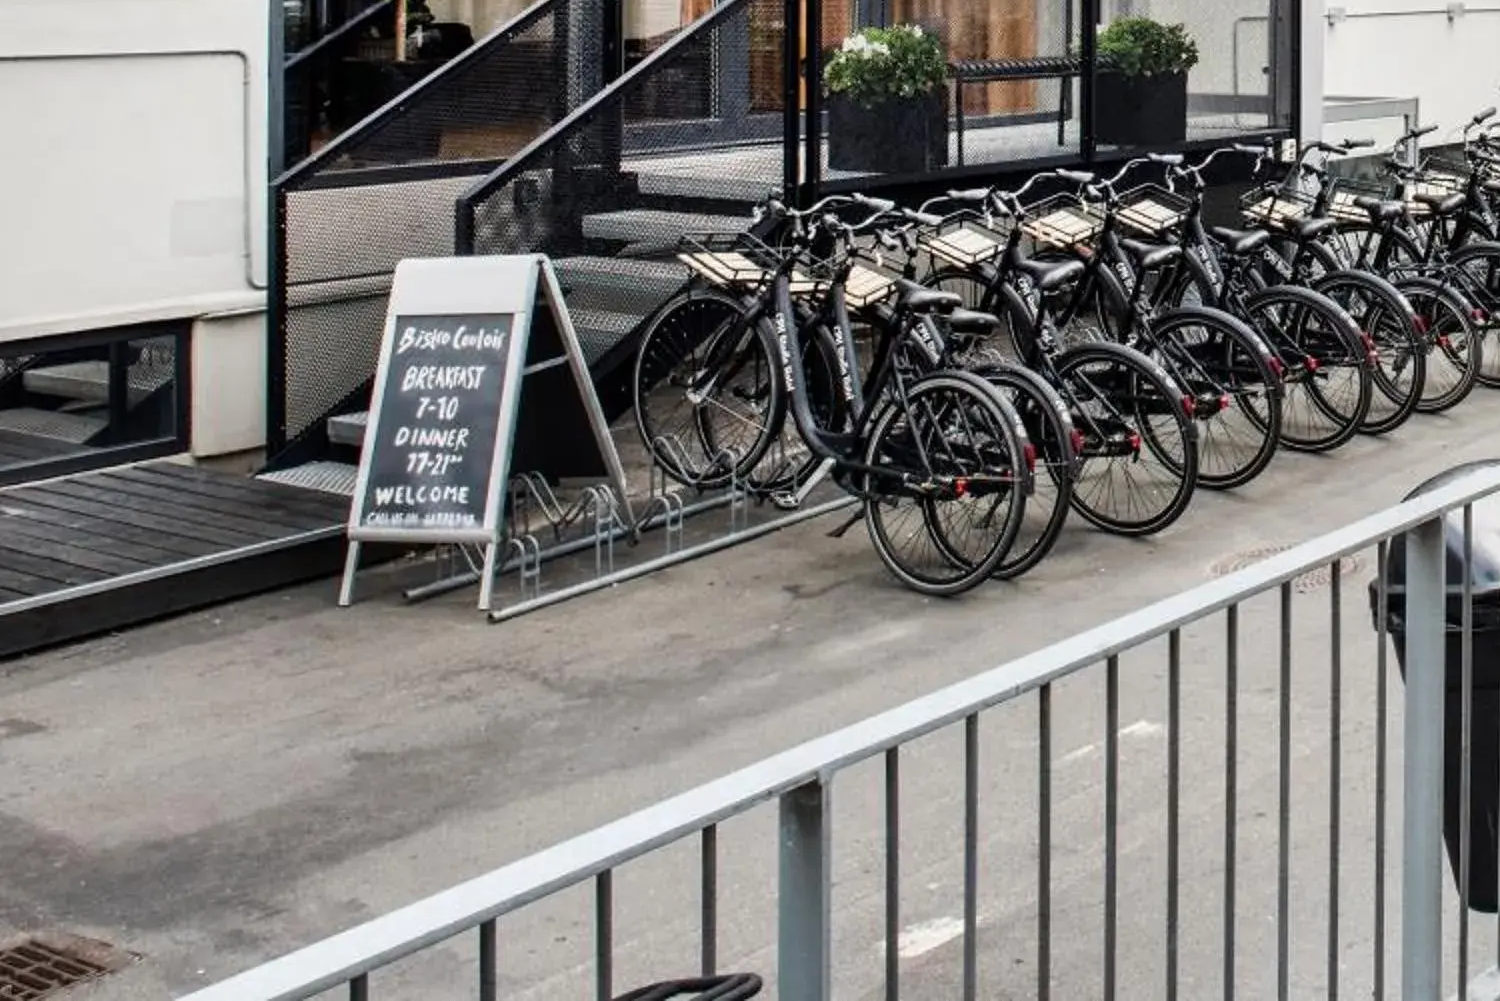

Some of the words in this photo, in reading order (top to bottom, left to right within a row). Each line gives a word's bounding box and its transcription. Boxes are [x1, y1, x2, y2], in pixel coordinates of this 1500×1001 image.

[402, 365, 486, 391] BREAKFAST
[415, 395, 459, 420] 7-10
[395, 427, 469, 450] DINNER
[375, 485, 470, 506] WELCOME
